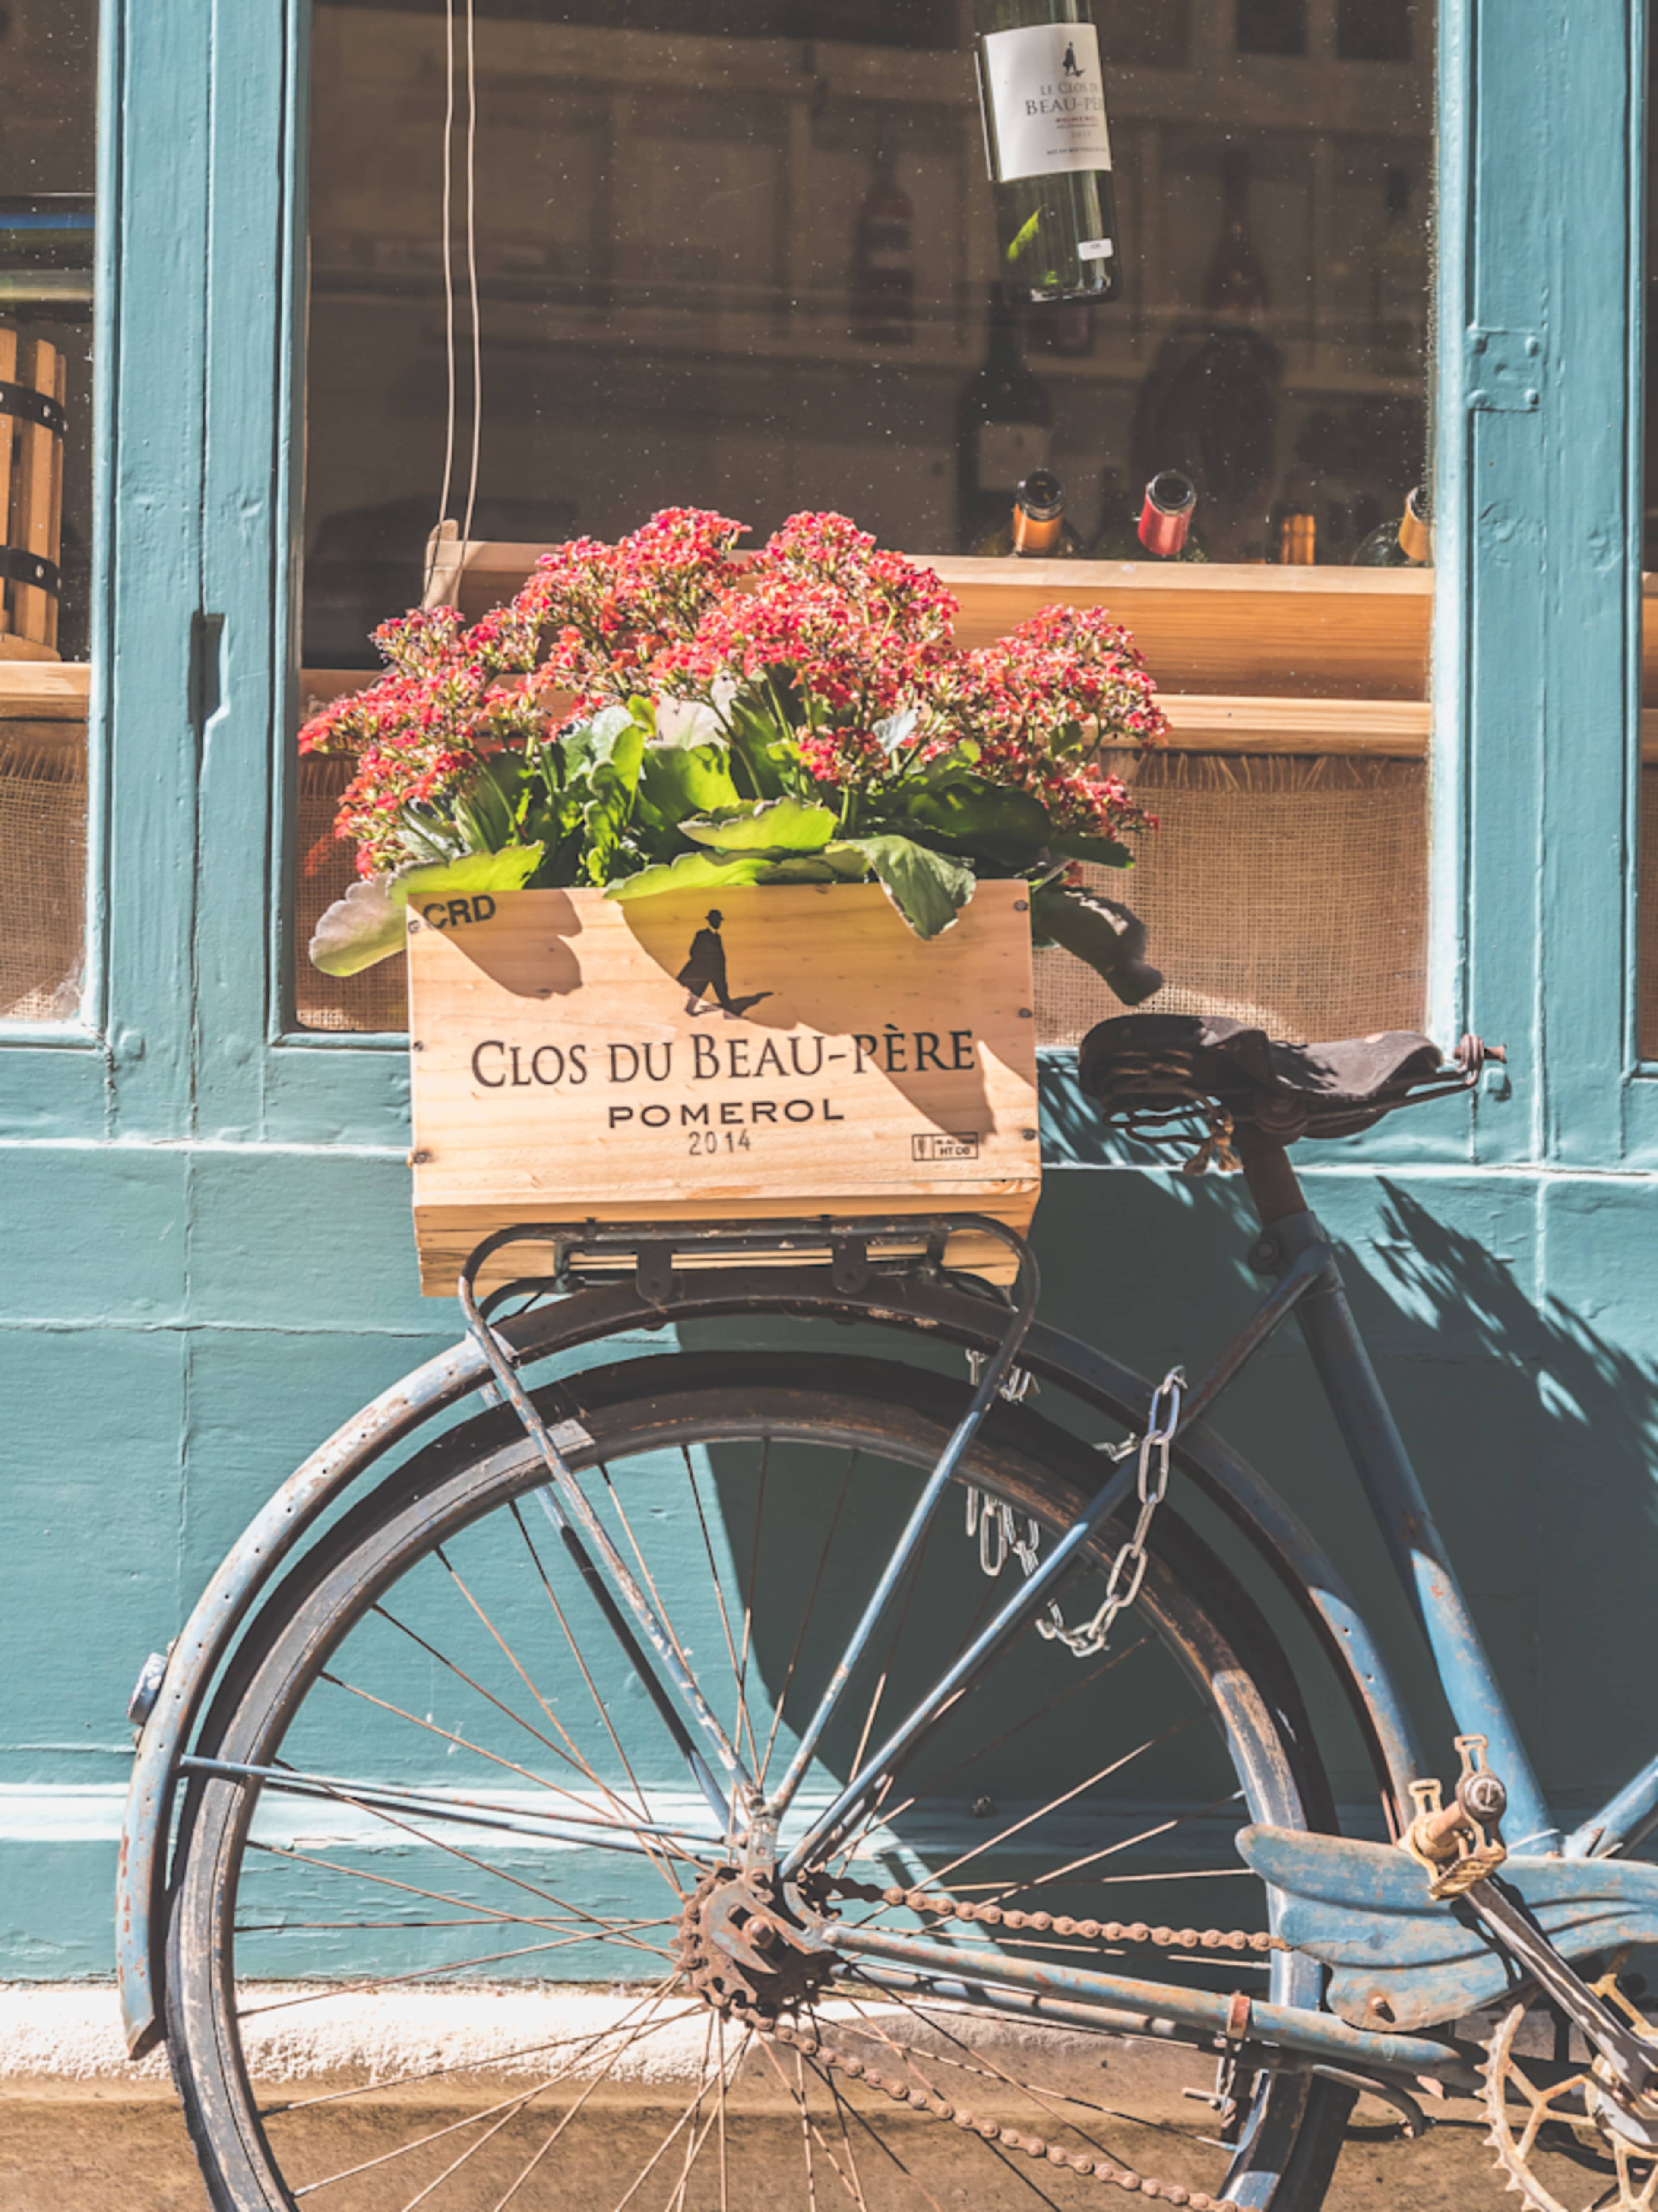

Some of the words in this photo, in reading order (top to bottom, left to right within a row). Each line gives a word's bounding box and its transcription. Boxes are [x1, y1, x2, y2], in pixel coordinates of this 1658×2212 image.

[423, 895, 496, 929] CRD
[609, 1099, 844, 1128] POMEROL
[689, 1129, 751, 1156] 2014
